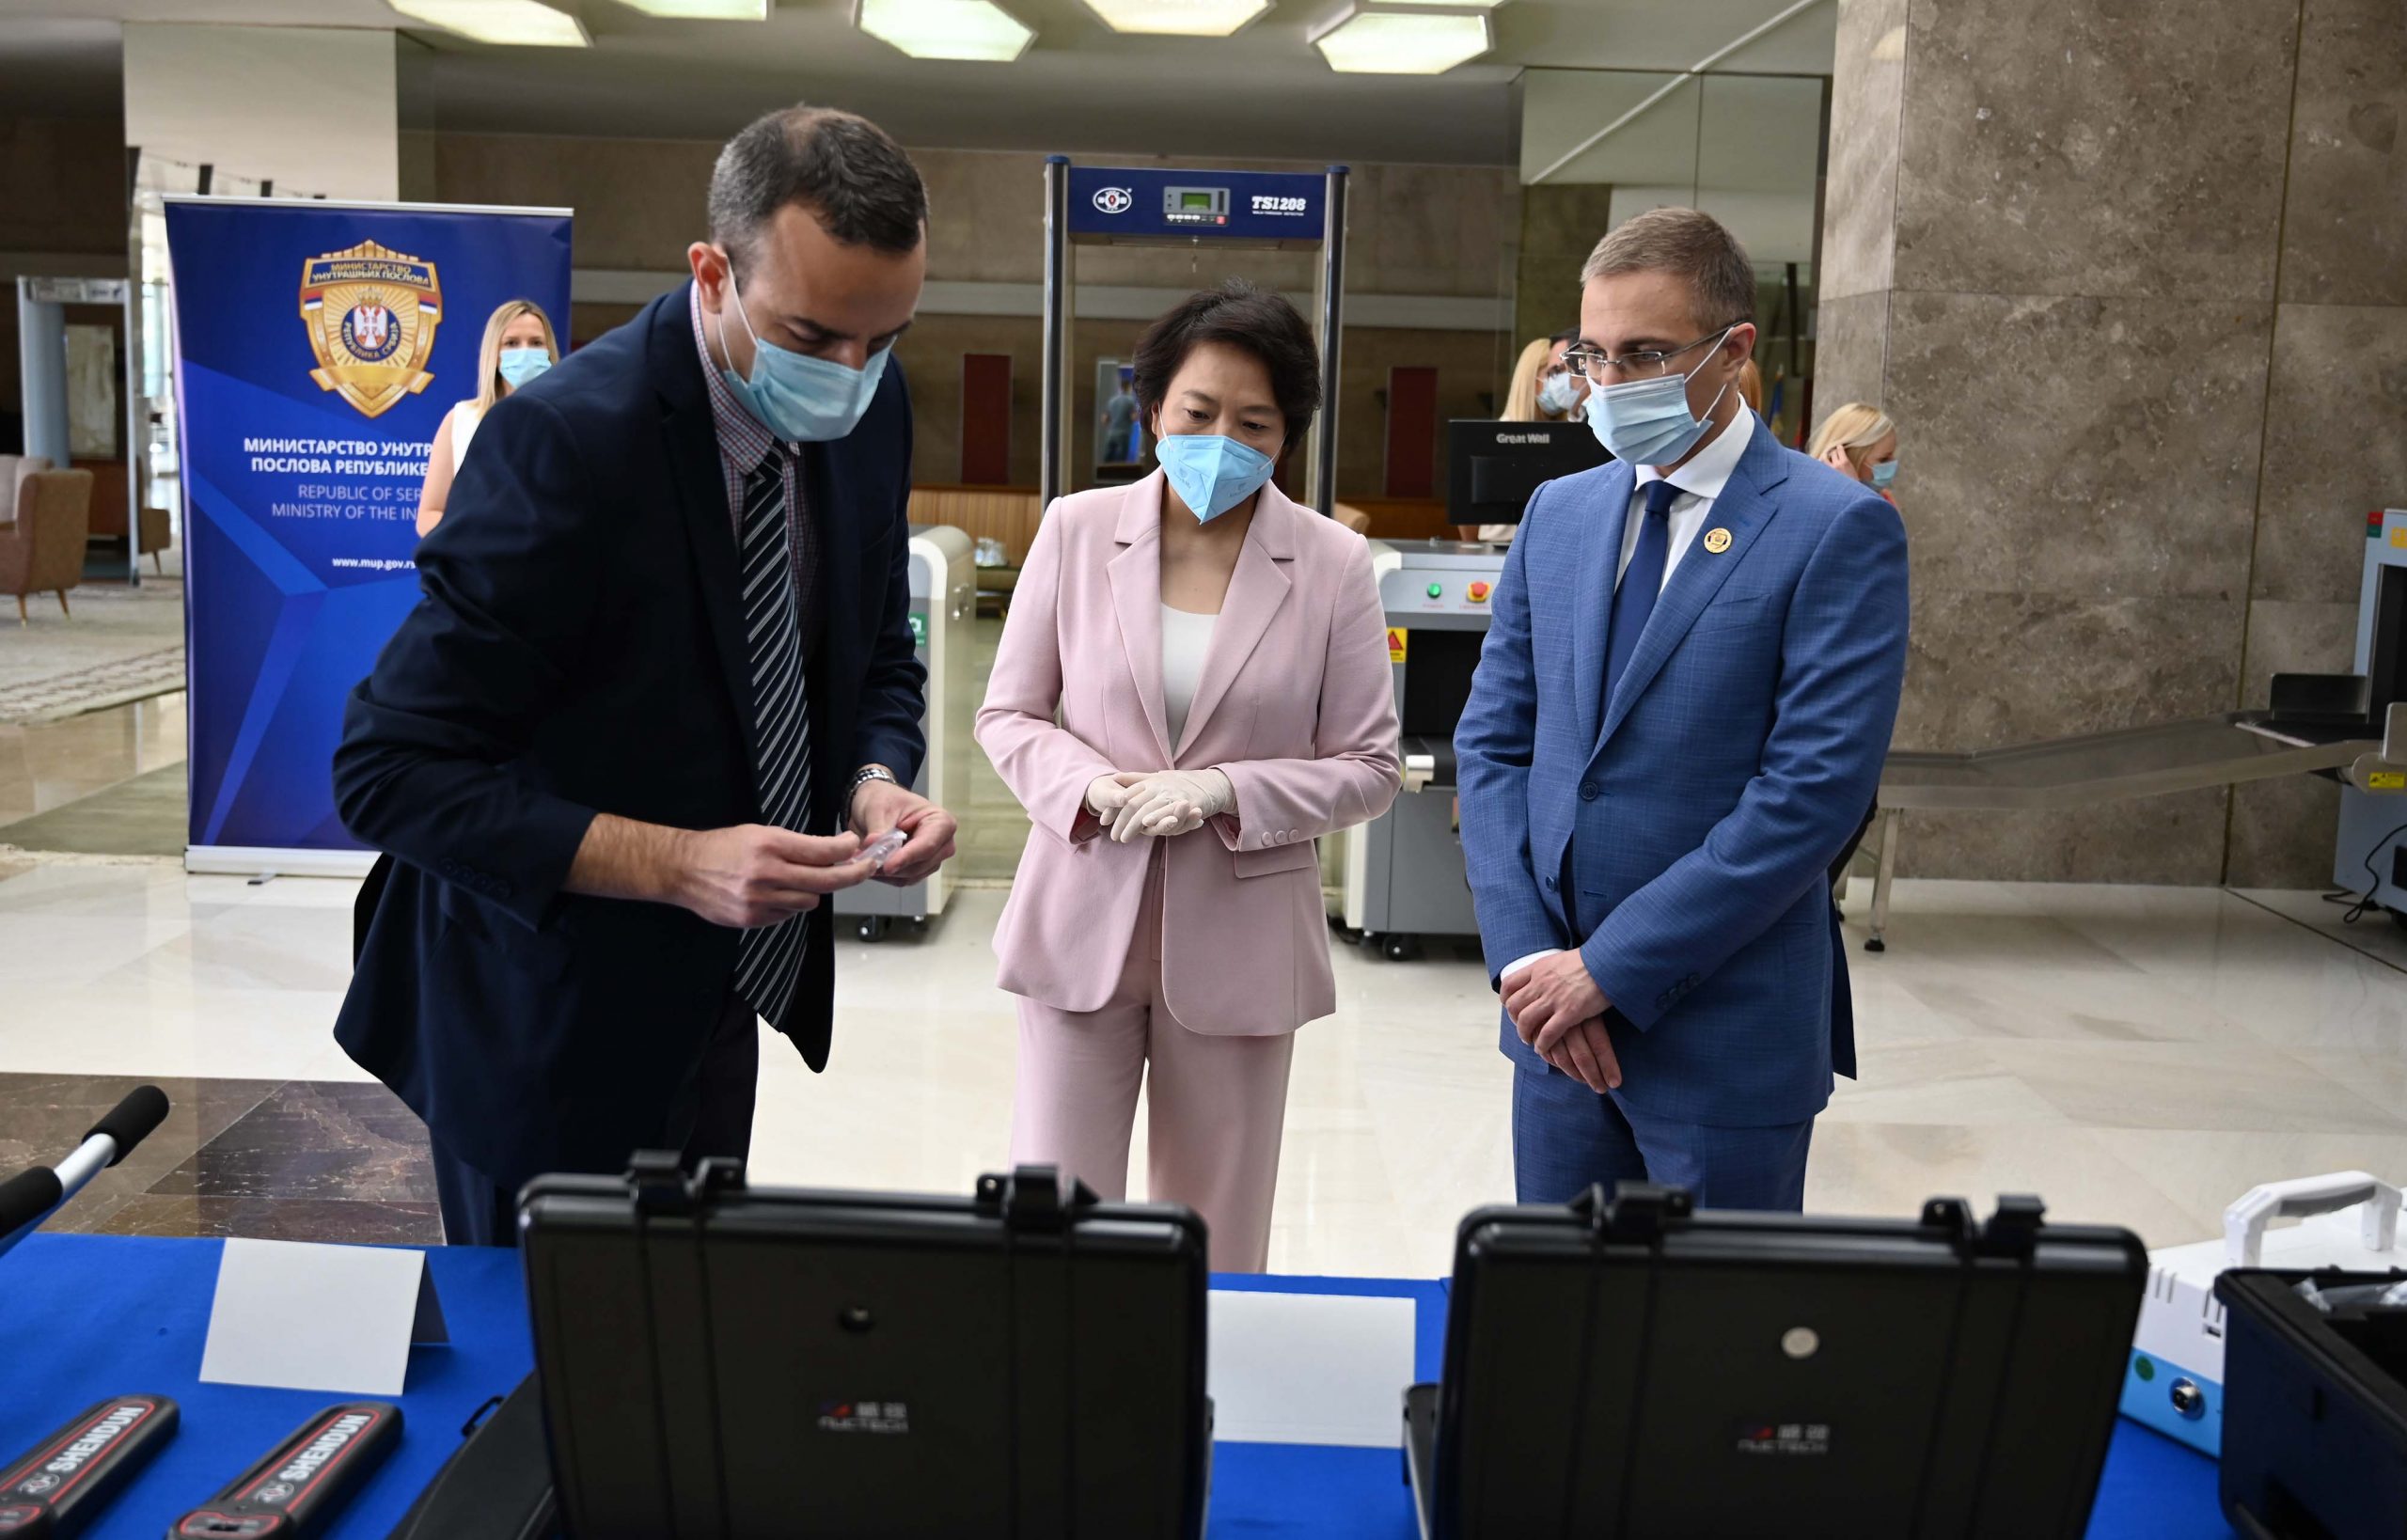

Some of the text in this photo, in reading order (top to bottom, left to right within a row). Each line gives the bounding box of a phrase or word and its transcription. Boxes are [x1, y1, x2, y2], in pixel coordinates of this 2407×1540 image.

[1251, 196, 1307, 211] TS1208
[331, 262, 412, 274] МИНИСТАРСТВО
[244, 438, 378, 455] МИНИСТАРСТВО
[1496, 433, 1550, 444] Great Wall
[251, 458, 429, 477] ПОСЛОВА РЕПУБЛИКЕ
[298, 484, 369, 500] REPUBLIC
[372, 487, 392, 501] OF
[272, 503, 341, 518] MINISTRY
[345, 505, 365, 519] OF
[369, 506, 397, 520] THE
[332, 558, 416, 571] www.mup.gov.rs
[46, 1406, 146, 1472] SHENDUN
[279, 1414, 371, 1482] SHENDUN
